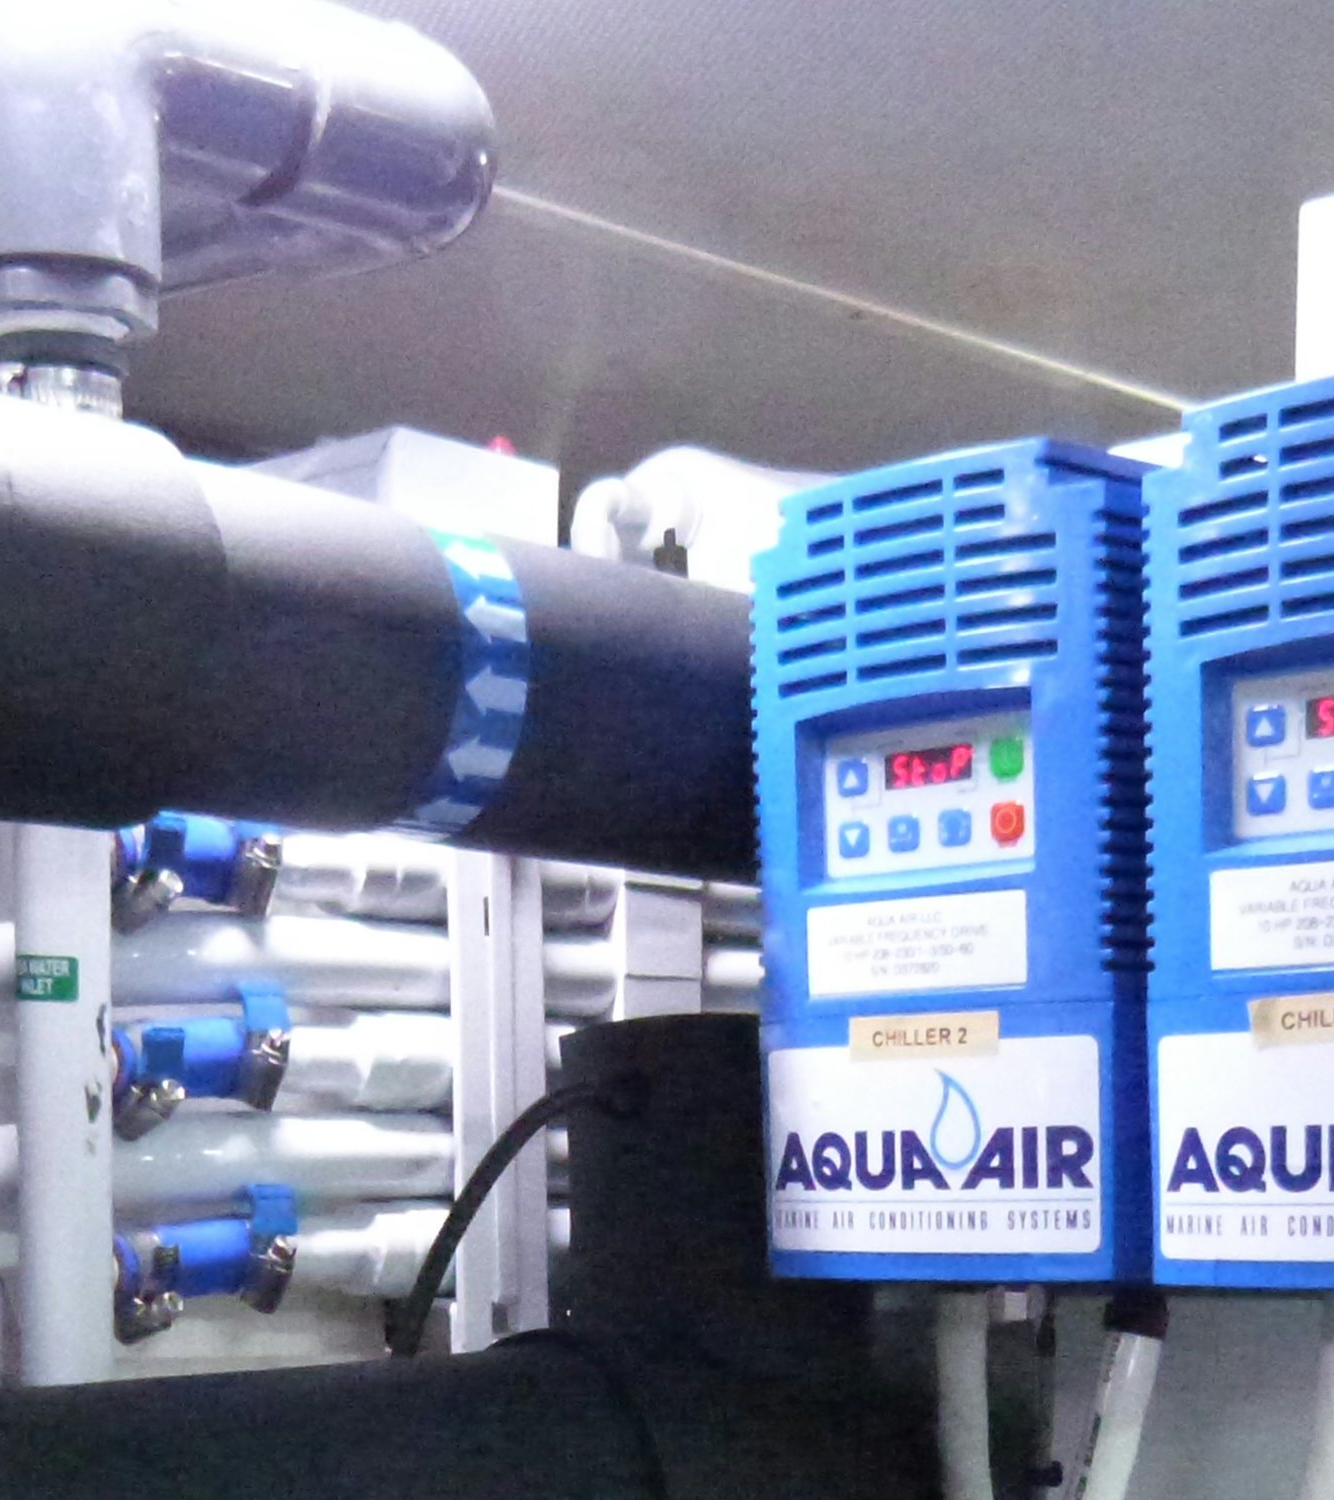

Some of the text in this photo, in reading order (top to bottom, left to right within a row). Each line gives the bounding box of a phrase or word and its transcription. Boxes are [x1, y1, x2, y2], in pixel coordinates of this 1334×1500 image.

[1289, 879, 1327, 893] AQUA
[1239, 897, 1298, 915] VARIABLE
[872, 1027, 968, 1047] CHILLER 2
[774, 1124, 1095, 1191] AQUA AIR
[832, 1210, 855, 1230] AIR
[869, 1210, 989, 1231] CONDITIONING
[1007, 1208, 1092, 1231] SYSTEMS
[1166, 1214, 1224, 1237] MARINE
[1240, 1215, 1269, 1237] AIR
